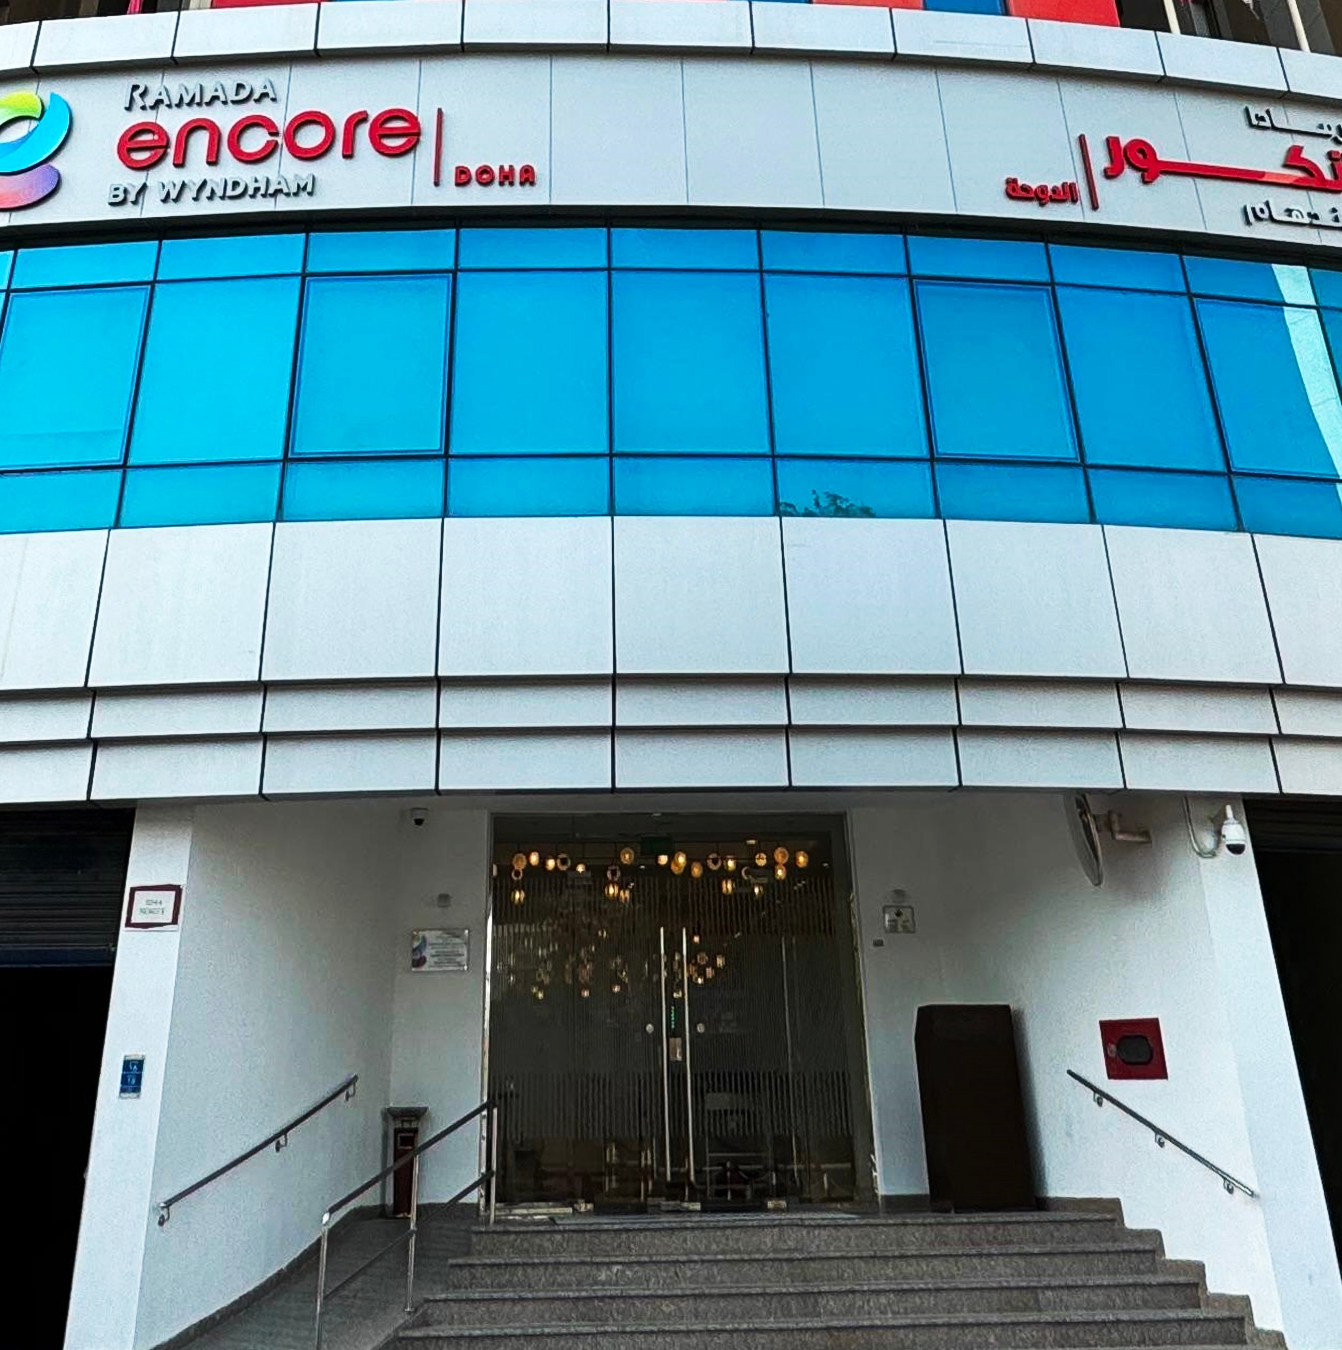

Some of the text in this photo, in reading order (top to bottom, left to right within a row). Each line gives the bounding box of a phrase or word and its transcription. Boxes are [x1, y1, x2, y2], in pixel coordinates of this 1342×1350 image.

[124, 77, 278, 111] RAMADA
[117, 107, 422, 171] encore
[107, 173, 316, 206] BY WYNDHAM
[454, 164, 536, 188] DOHA
[1004, 176, 1079, 207] الدوحة
